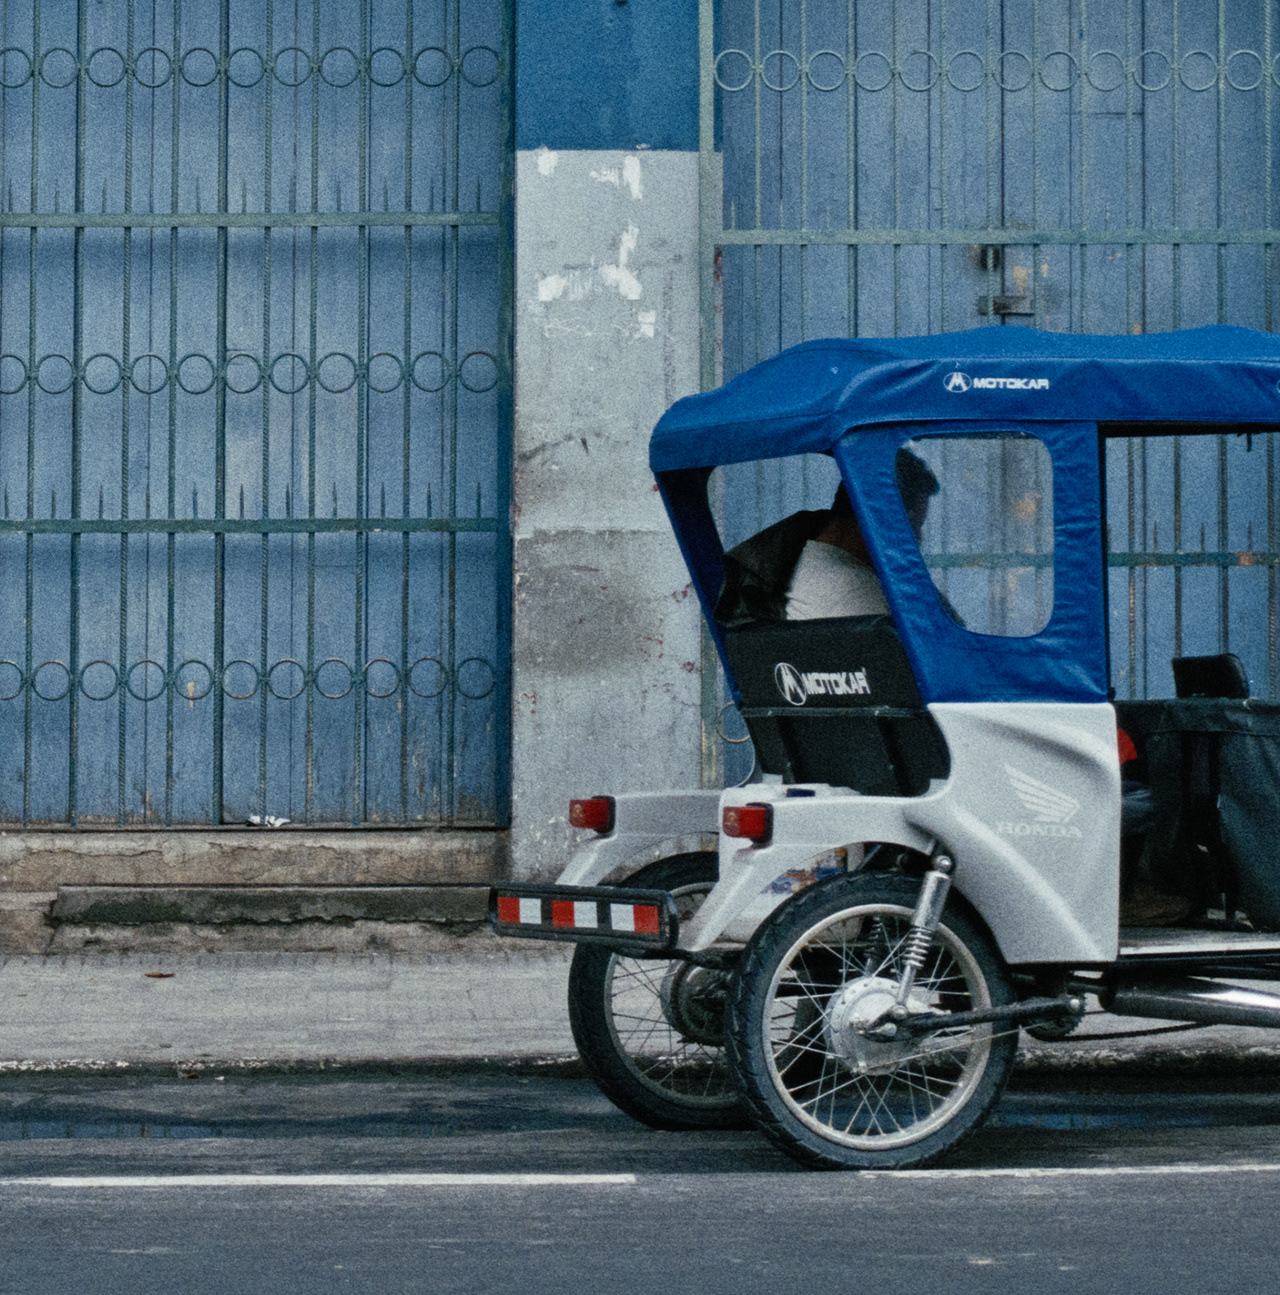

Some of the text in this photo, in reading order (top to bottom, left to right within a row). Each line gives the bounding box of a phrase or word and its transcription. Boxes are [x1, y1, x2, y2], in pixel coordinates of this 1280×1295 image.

[973, 377, 1049, 390] MOTOKAR
[801, 671, 871, 695] MOTOKAR
[998, 823, 1083, 837] HONDA
